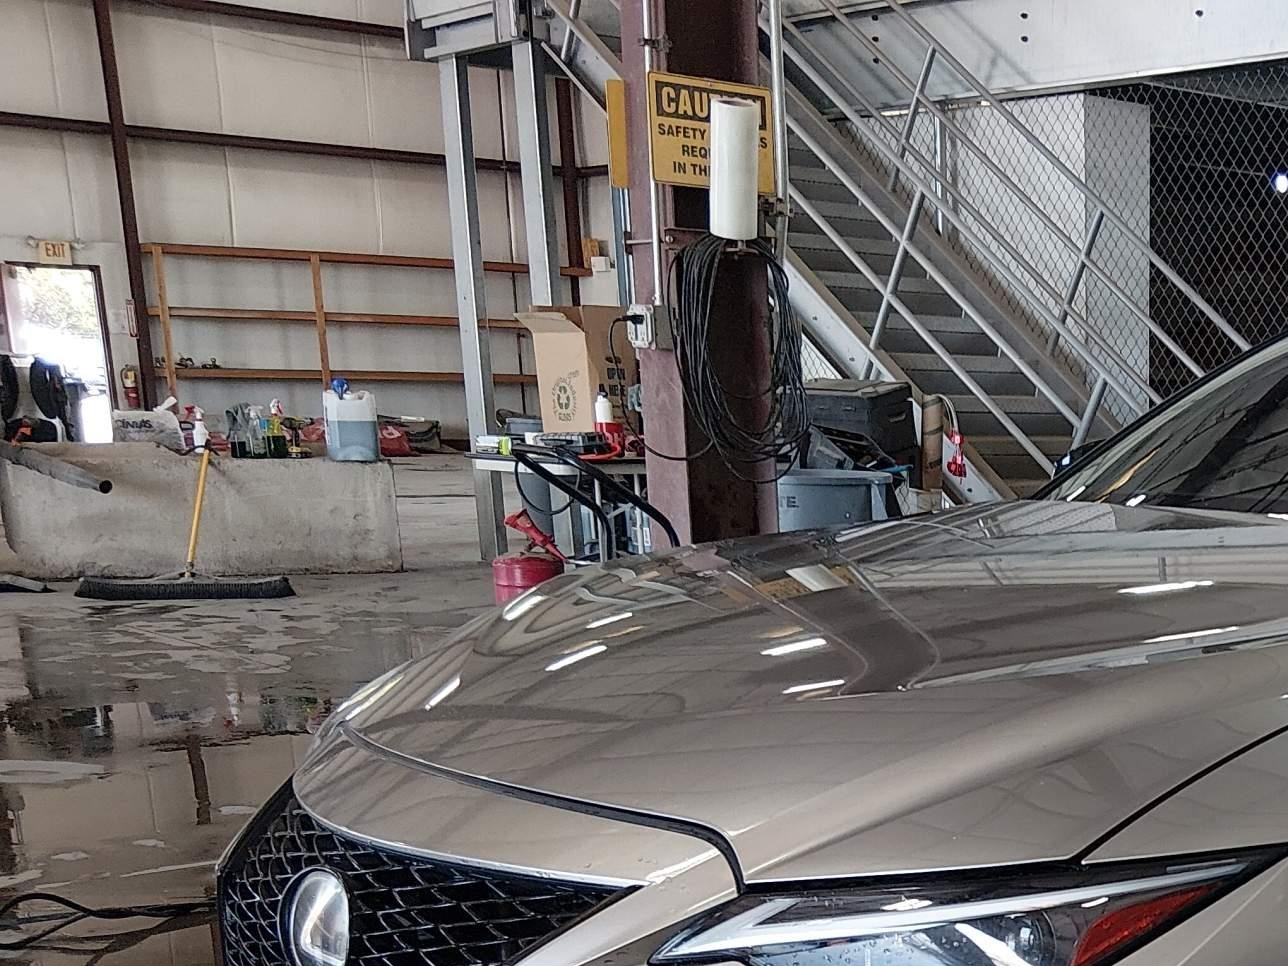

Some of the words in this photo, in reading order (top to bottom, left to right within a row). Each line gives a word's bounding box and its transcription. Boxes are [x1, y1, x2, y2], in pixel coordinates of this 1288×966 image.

[658, 123, 706, 140] SAFETY
[673, 160, 686, 174] IN
[45, 243, 65, 258] EXIT
